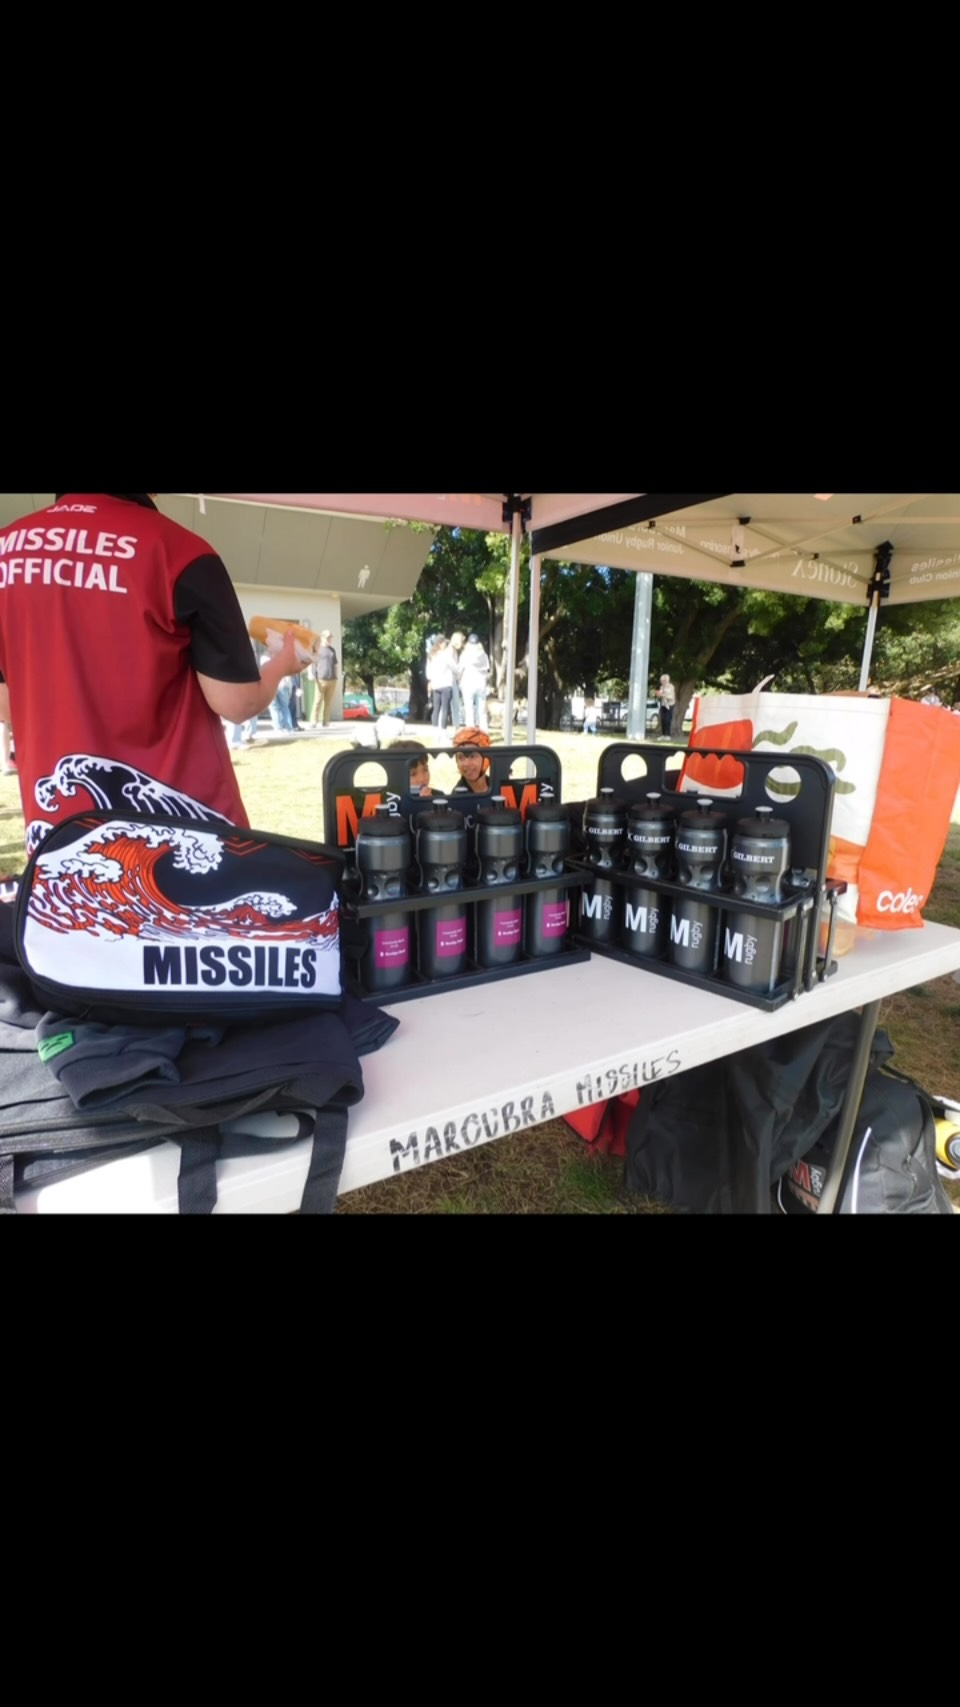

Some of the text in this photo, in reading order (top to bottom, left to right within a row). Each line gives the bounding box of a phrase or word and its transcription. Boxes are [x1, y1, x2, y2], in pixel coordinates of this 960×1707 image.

[46, 504, 98, 513] JADE
[0, 527, 138, 559] MISSILES
[0, 558, 128, 594] OFFICIAL
[588, 827, 624, 836] GILBERT
[633, 834, 671, 844] GILBERT
[678, 842, 718, 854] GILBERT
[733, 851, 775, 864] GILBERT
[744, 934, 758, 965] rugby
[143, 945, 317, 988] MISSILES
[576, 1049, 681, 1104] MISSILES
